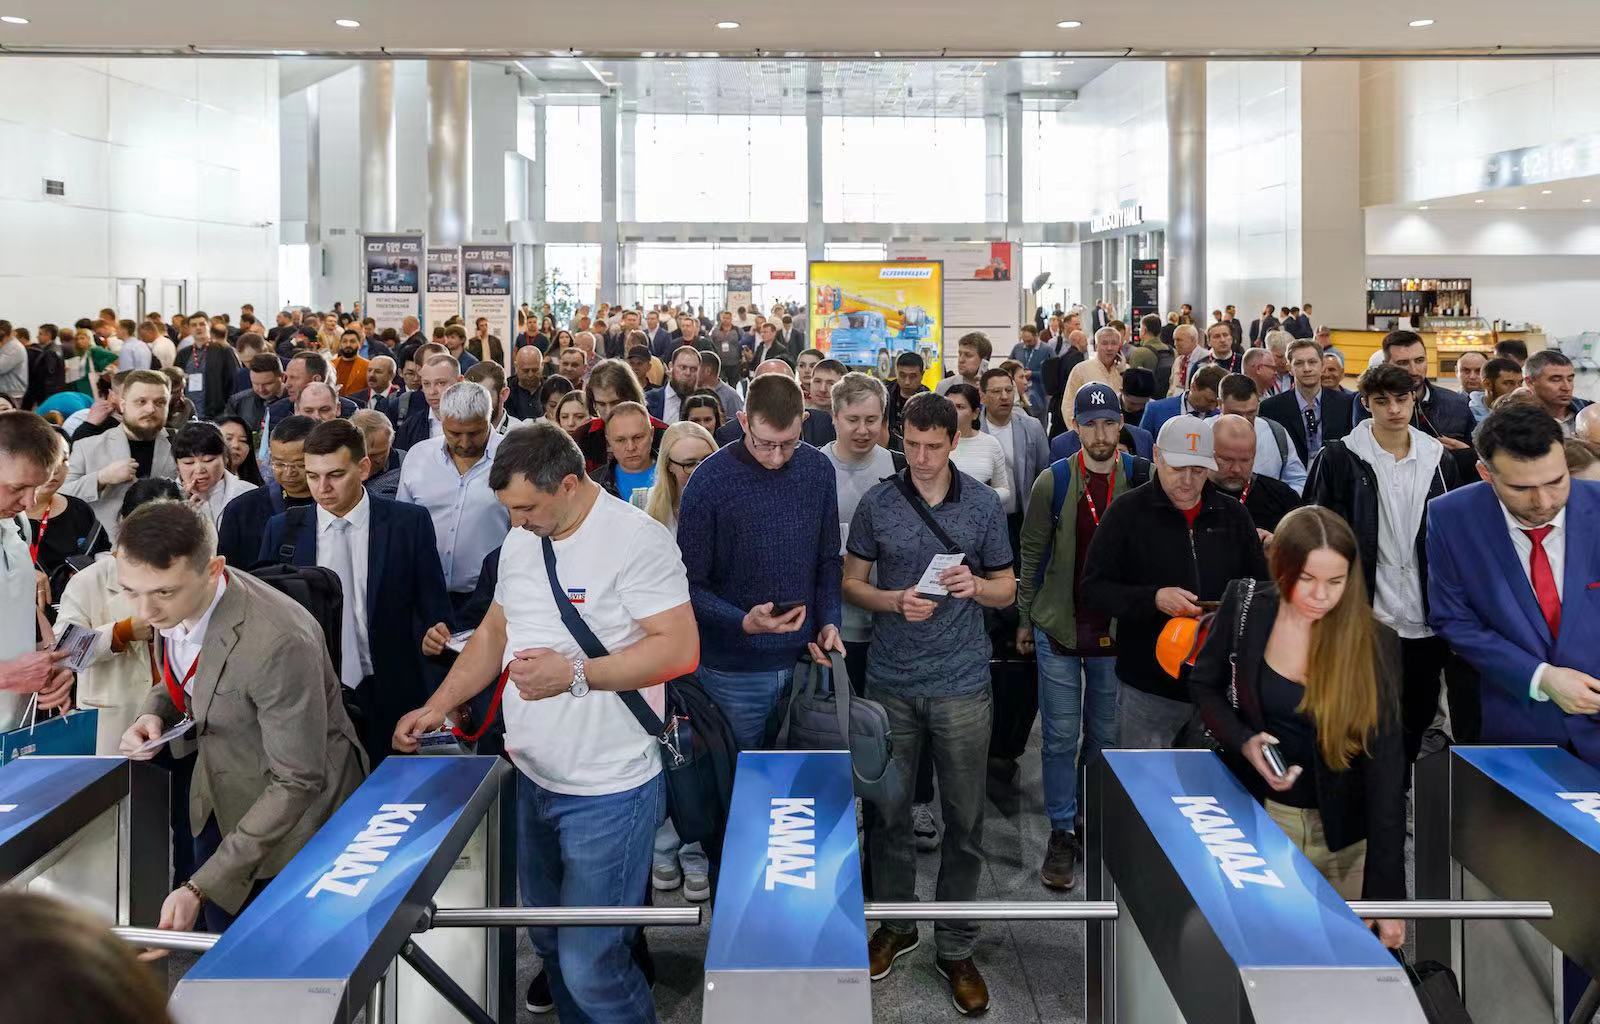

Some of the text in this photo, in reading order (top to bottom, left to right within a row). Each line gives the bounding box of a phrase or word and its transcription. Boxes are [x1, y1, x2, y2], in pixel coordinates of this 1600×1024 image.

[1090, 391, 1106, 405] NY
[1185, 432, 1201, 452] T
[306, 803, 426, 898] KAMAZ
[764, 798, 816, 890] KAMAZ
[1171, 796, 1286, 889] KAMAZ
